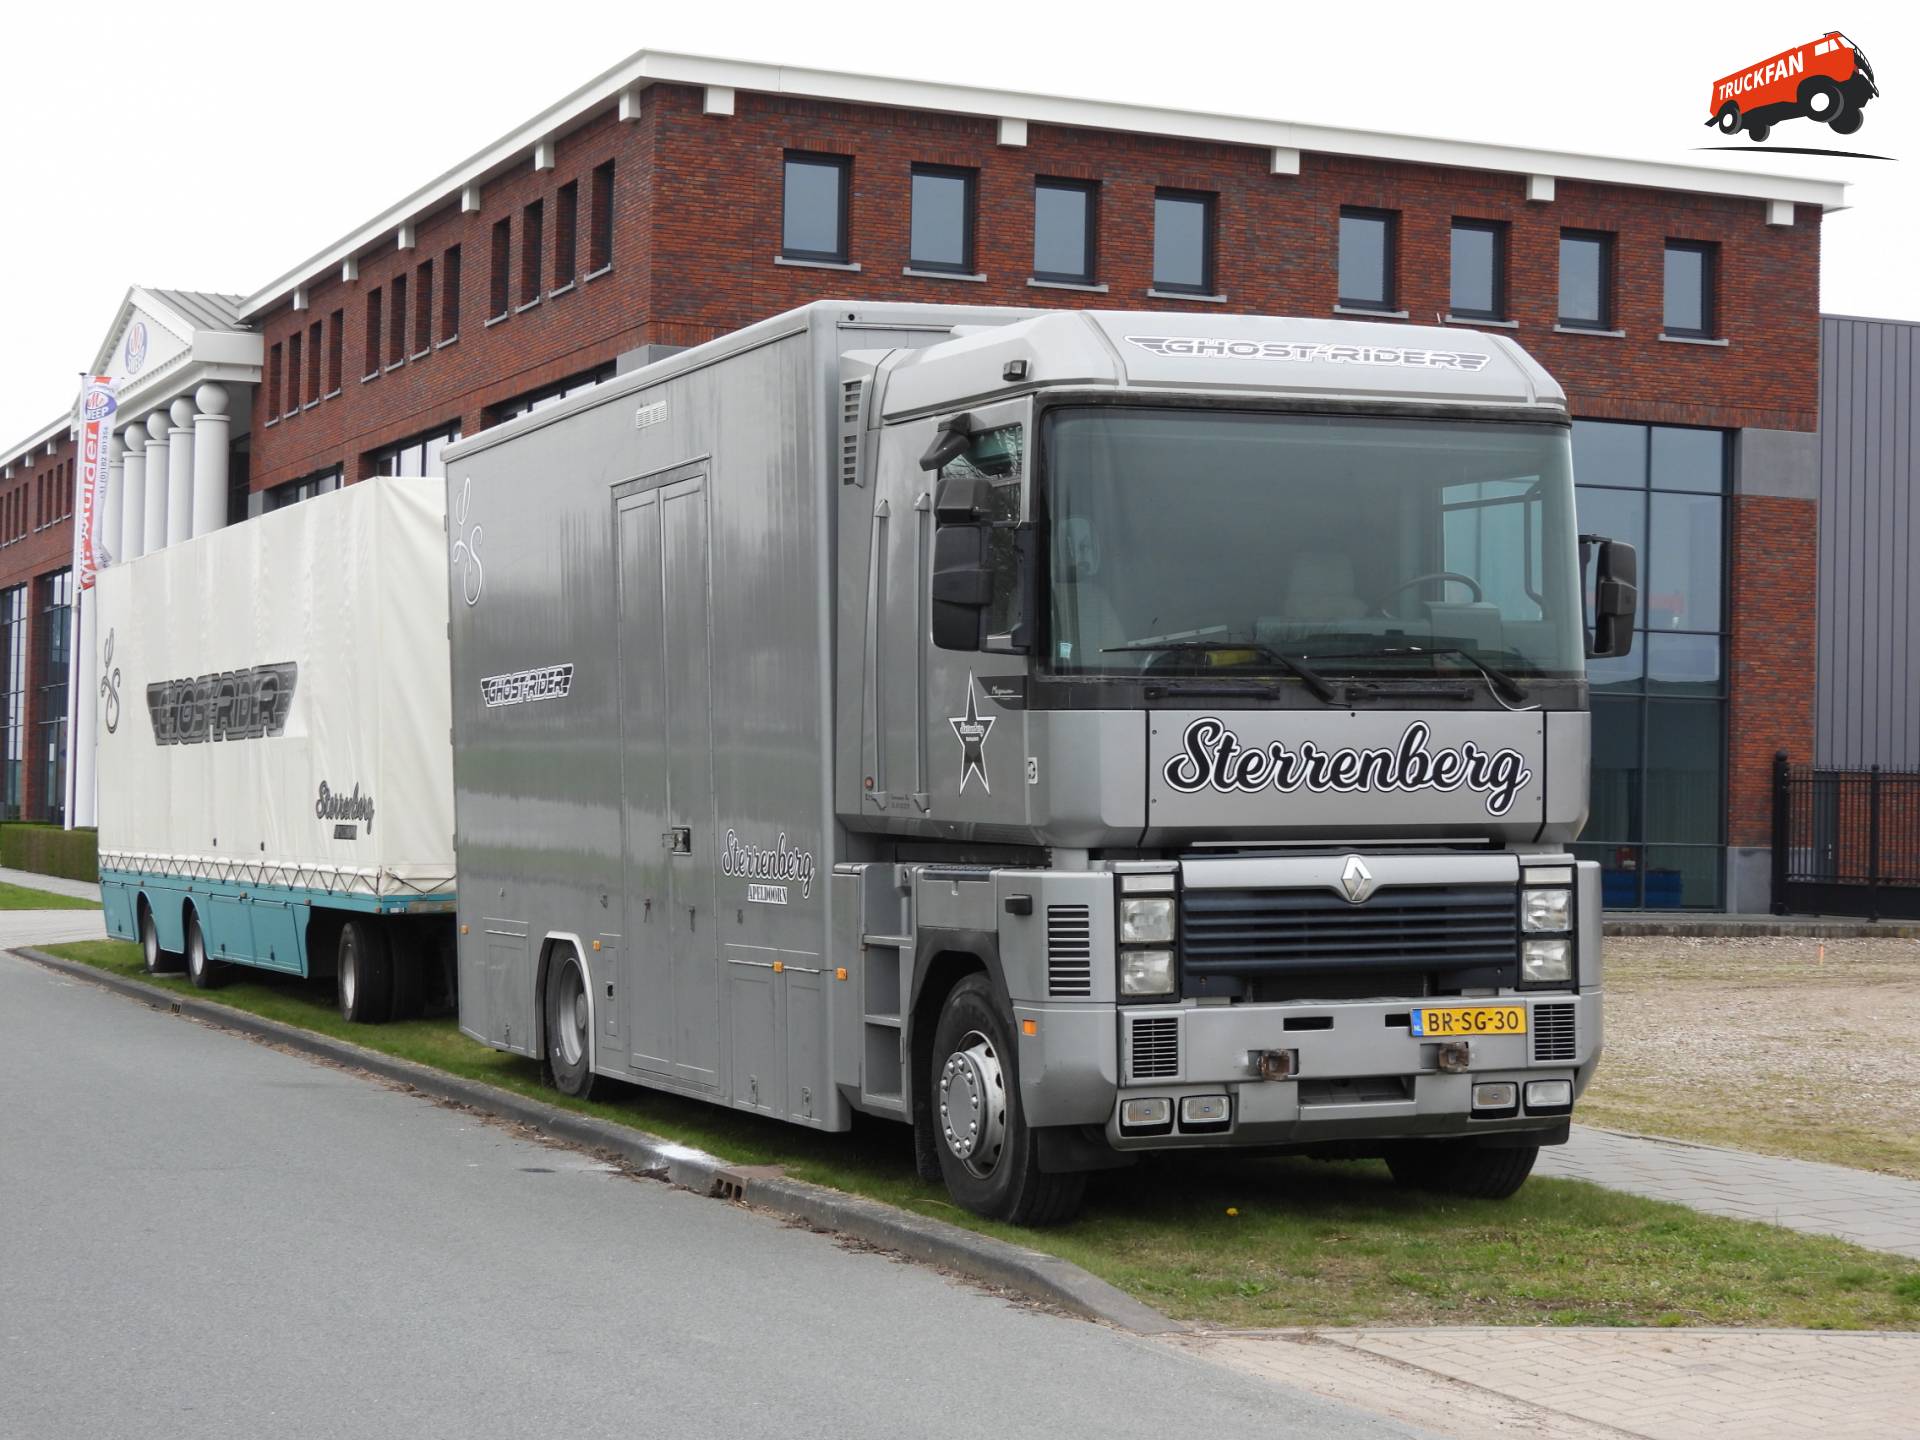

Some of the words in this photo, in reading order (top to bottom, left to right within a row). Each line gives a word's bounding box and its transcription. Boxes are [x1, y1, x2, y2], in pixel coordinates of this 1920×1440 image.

[1164, 718, 1531, 815] Sterrenberg
[722, 828, 815, 899] Sterrenberg
[1428, 1010, 1519, 1032] BR-SG-30
